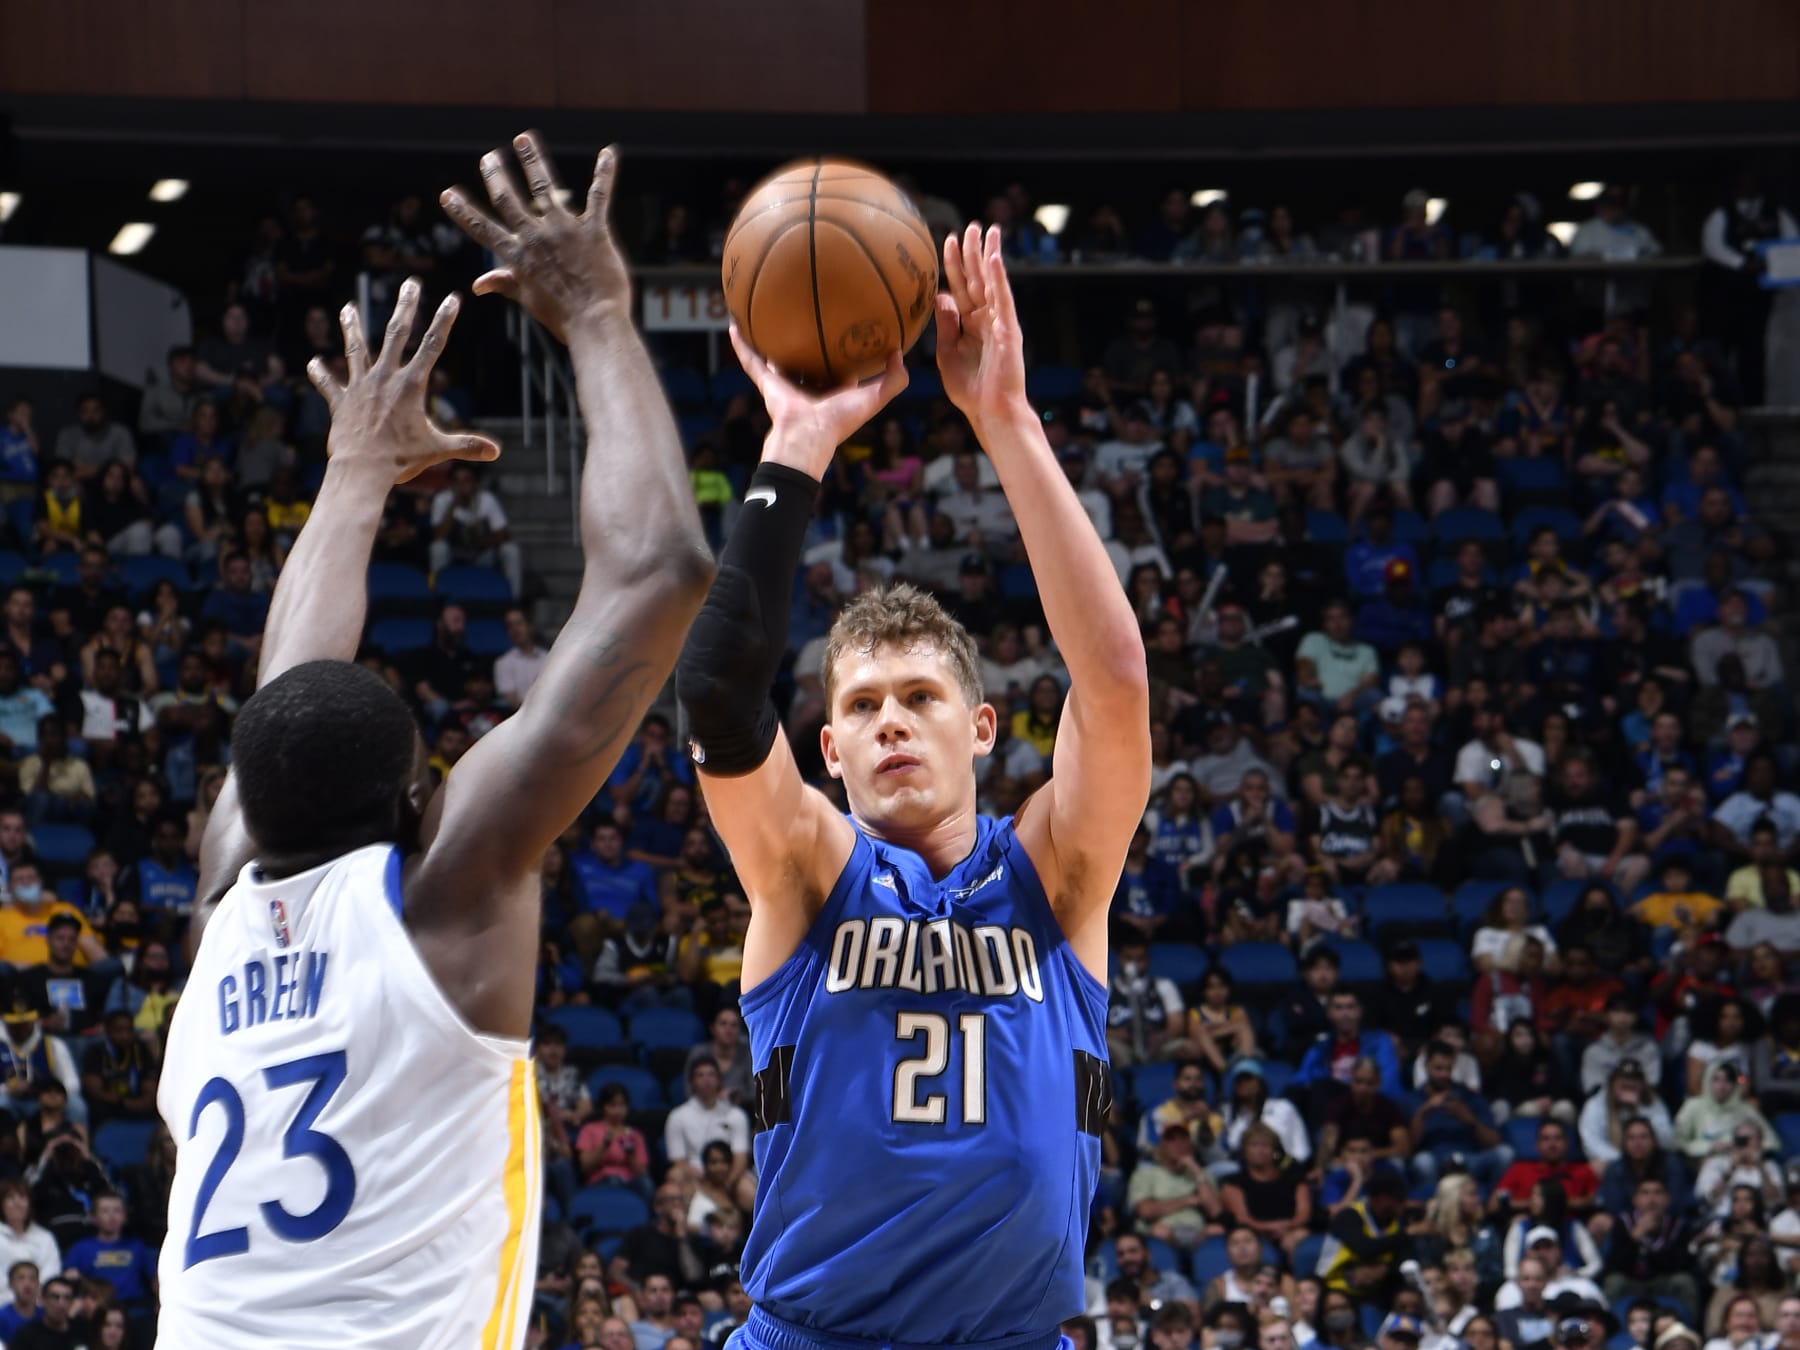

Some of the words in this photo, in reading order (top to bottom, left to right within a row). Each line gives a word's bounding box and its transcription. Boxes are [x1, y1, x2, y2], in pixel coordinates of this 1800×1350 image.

[217, 951, 328, 1036] GREEN
[825, 917, 1045, 1004] ORLANDO
[892, 1010, 987, 1125] 21
[182, 1049, 357, 1273] 23
